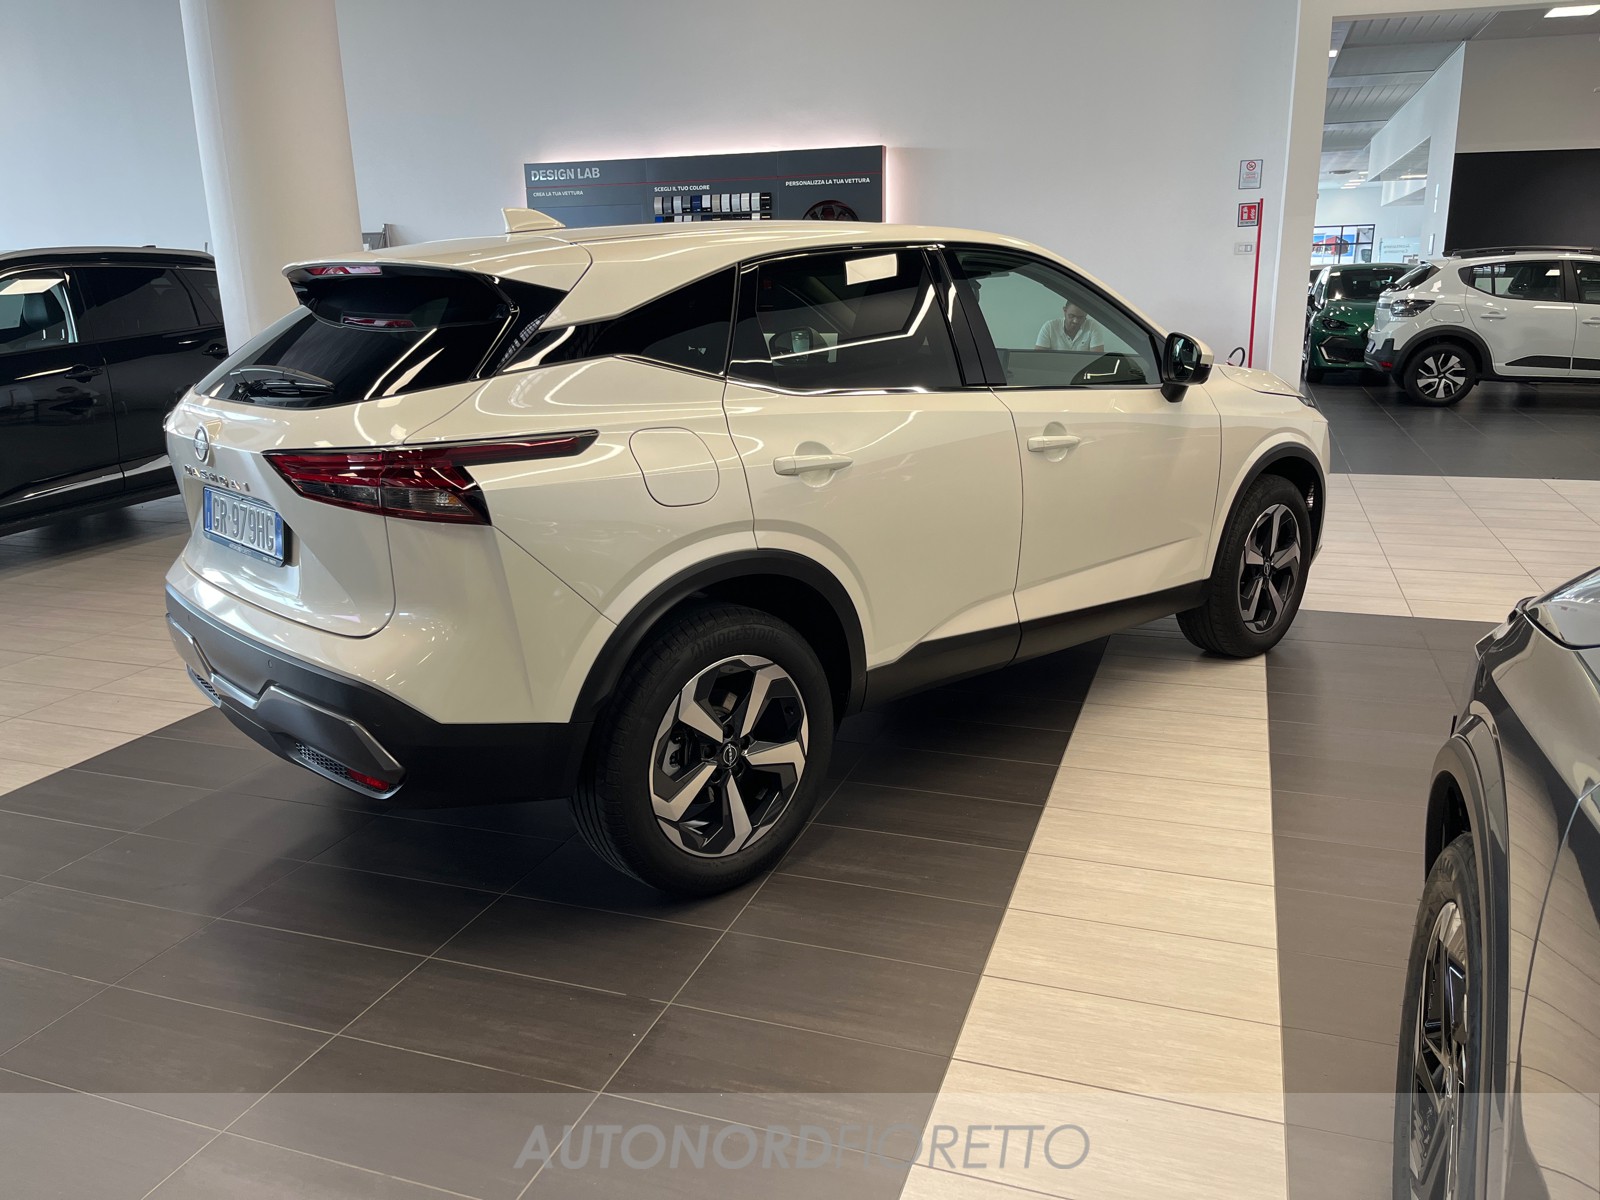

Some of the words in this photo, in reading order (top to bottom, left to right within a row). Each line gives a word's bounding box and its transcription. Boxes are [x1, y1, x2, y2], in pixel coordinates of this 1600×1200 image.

[531, 168, 575, 181] DESIGN
[577, 167, 601, 179] LAB
[785, 179, 825, 187] PERSONALIZZA
[690, 626, 782, 660] BRIDGESTONE
